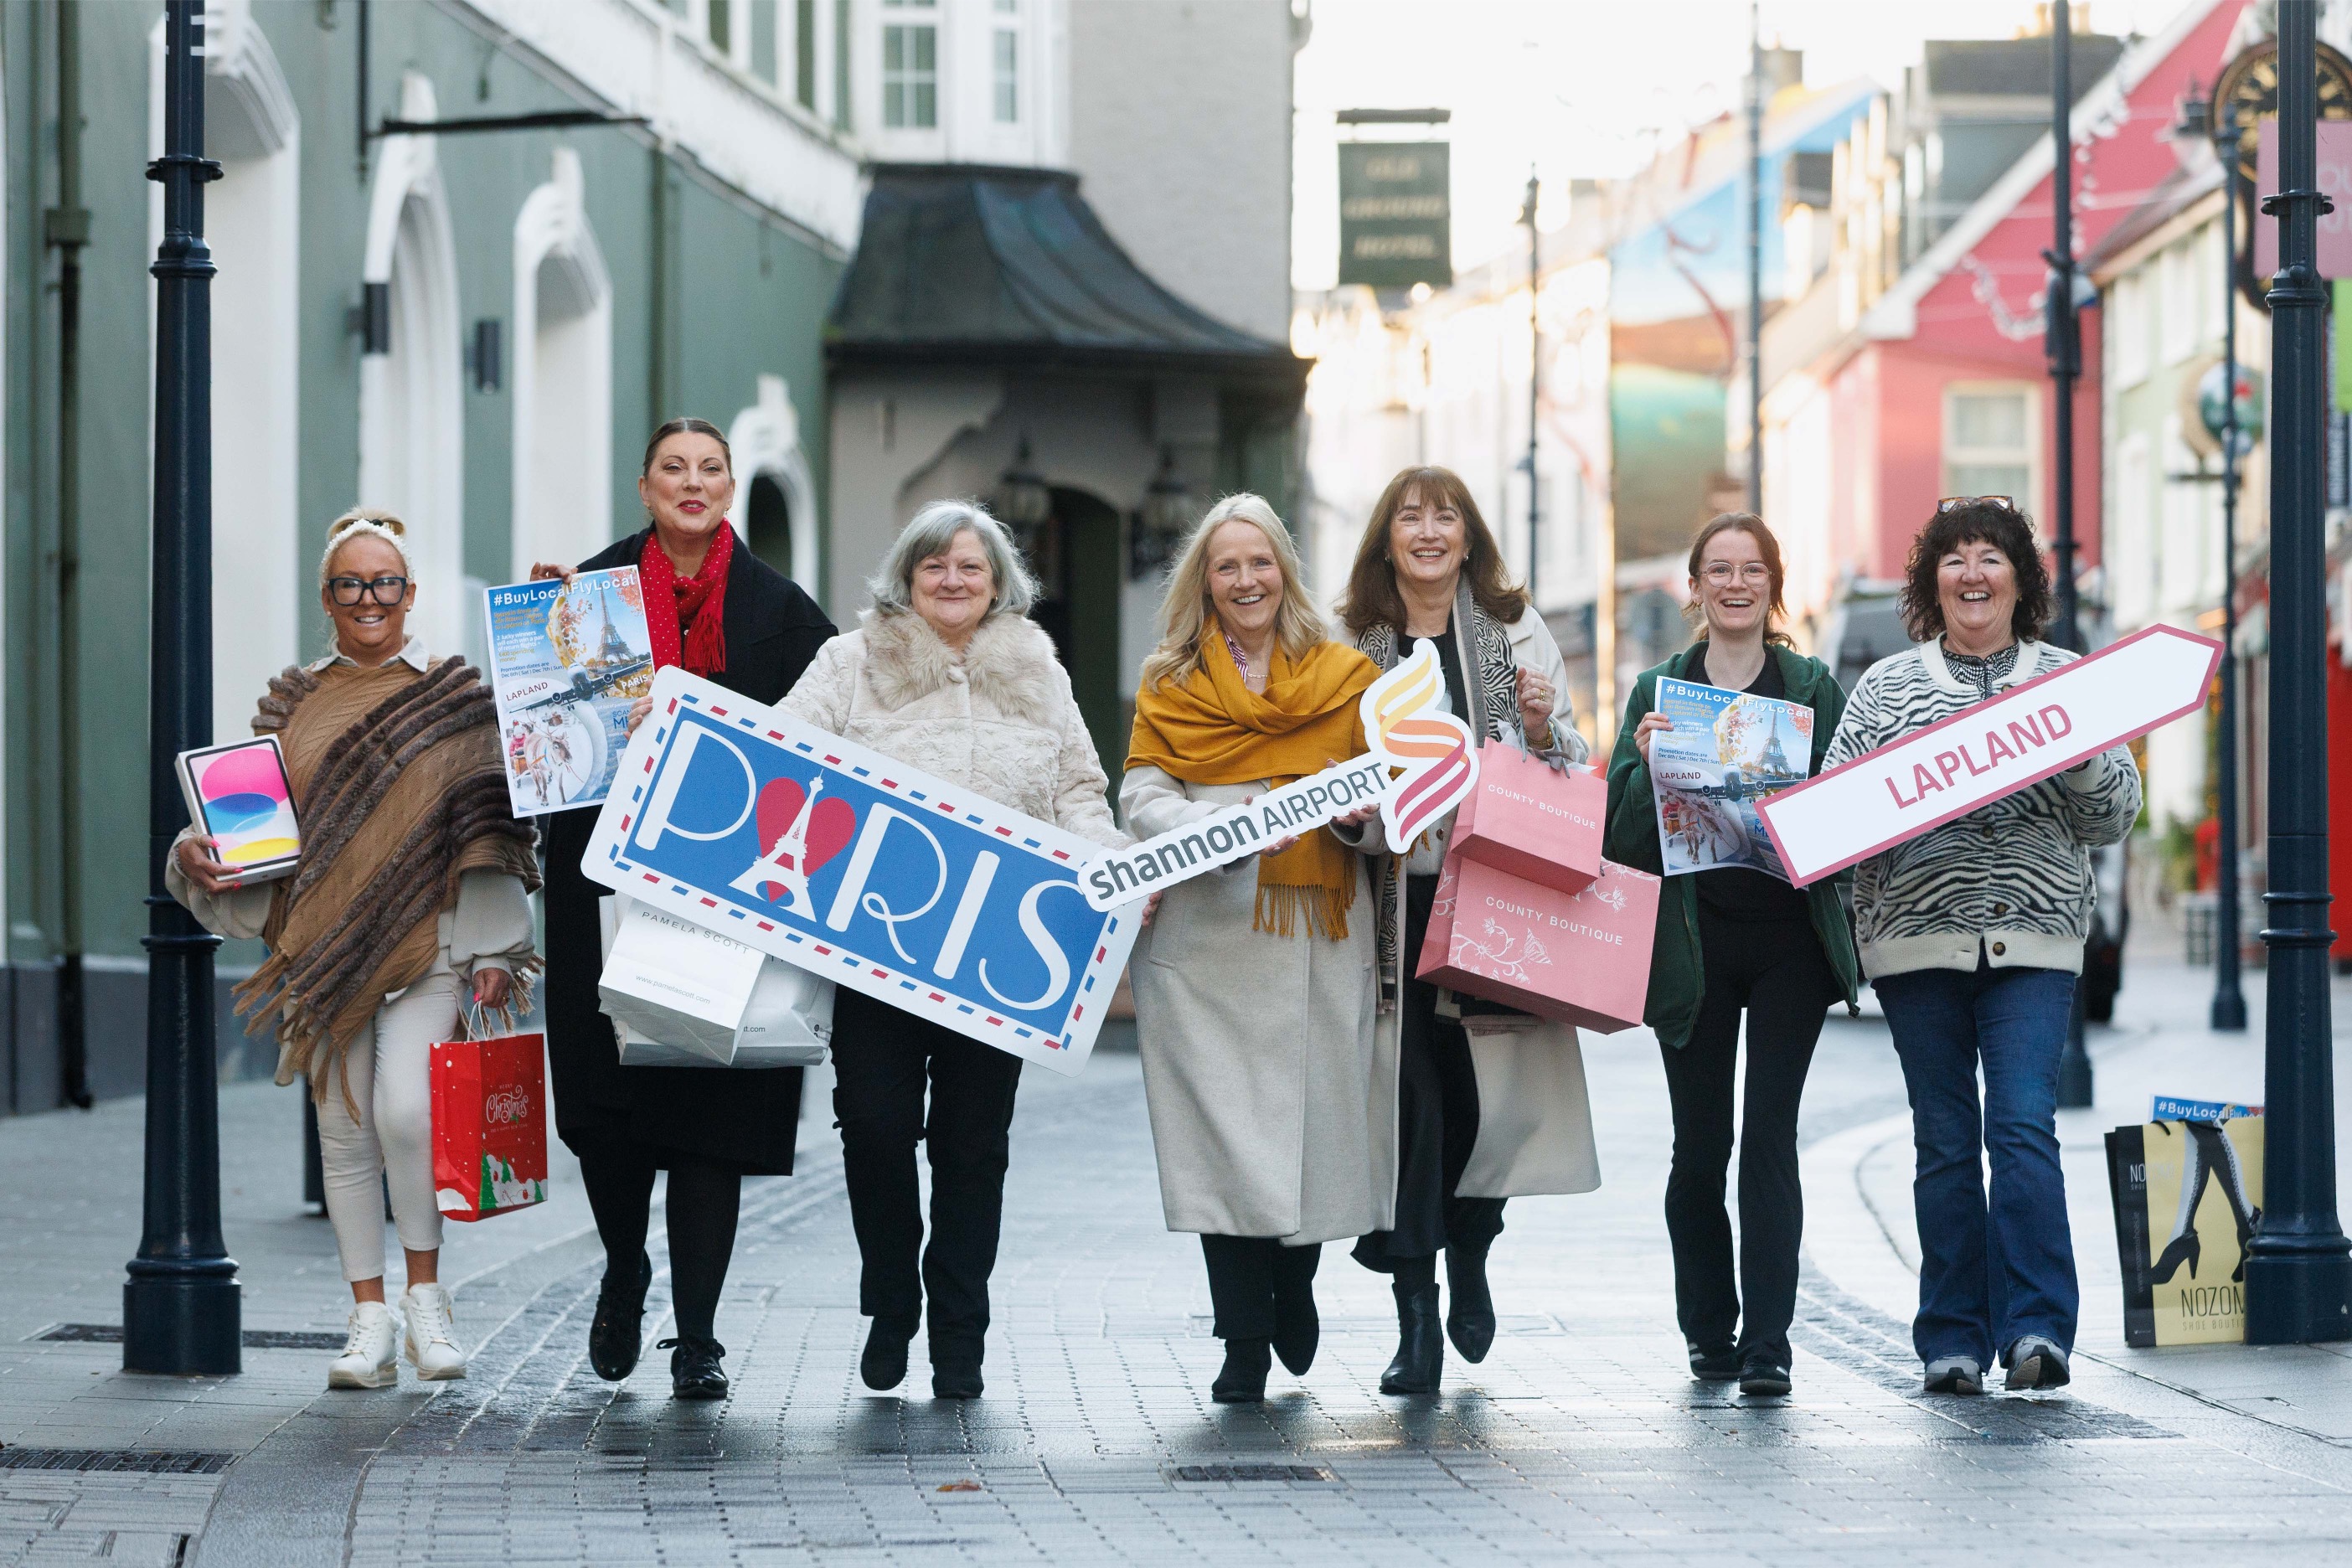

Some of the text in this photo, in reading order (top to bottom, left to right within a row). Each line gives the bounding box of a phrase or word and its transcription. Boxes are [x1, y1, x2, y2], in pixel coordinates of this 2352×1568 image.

[506, 682, 548, 702] LAPLAND
[621, 673, 648, 689] PARIS
[1658, 747, 1684, 756] Promotion
[1885, 704, 2072, 809] LAPLAND
[1659, 771, 1701, 780] LAPLAND
[1488, 784, 1596, 830] COUNTY BOUTIQUE
[1090, 762, 1387, 900] shannon AIRPORT
[642, 911, 750, 954] PAMELA SCOTT
[1486, 896, 1623, 946] COUNTY BOUTIQUE
[636, 974, 711, 1005] www.pamelascott.com
[486, 1085, 529, 1123] Christmas
[2183, 1320, 2205, 1331] SHOE
